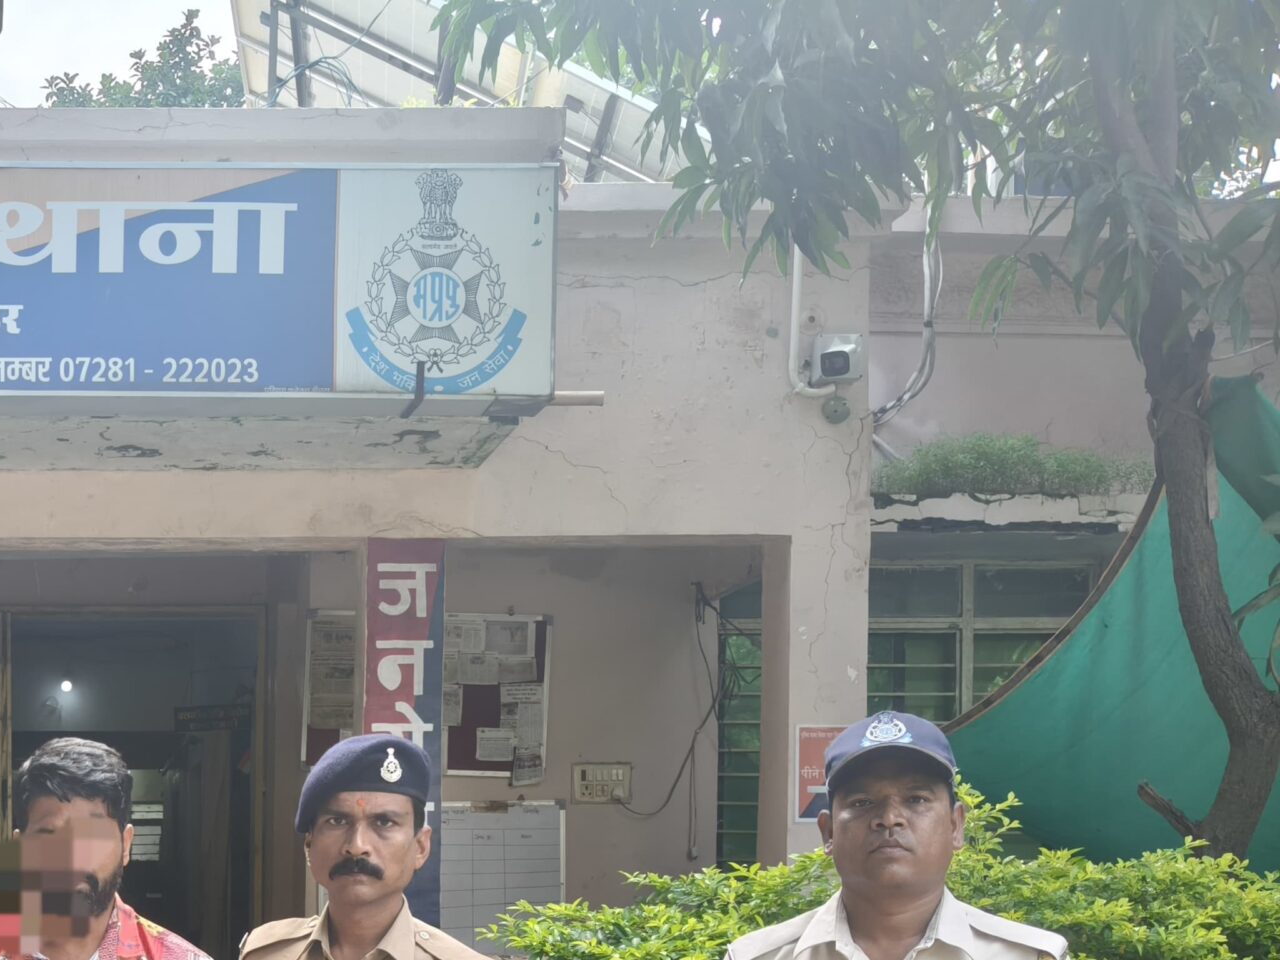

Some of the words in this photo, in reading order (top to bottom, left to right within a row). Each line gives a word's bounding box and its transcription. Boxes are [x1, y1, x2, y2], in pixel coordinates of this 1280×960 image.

[59, 357, 136, 383] 07281
[162, 357, 259, 384] 222023
[369, 351, 390, 374] देश
[457, 372, 481, 390] जन
[482, 351, 510, 374] सेवा
